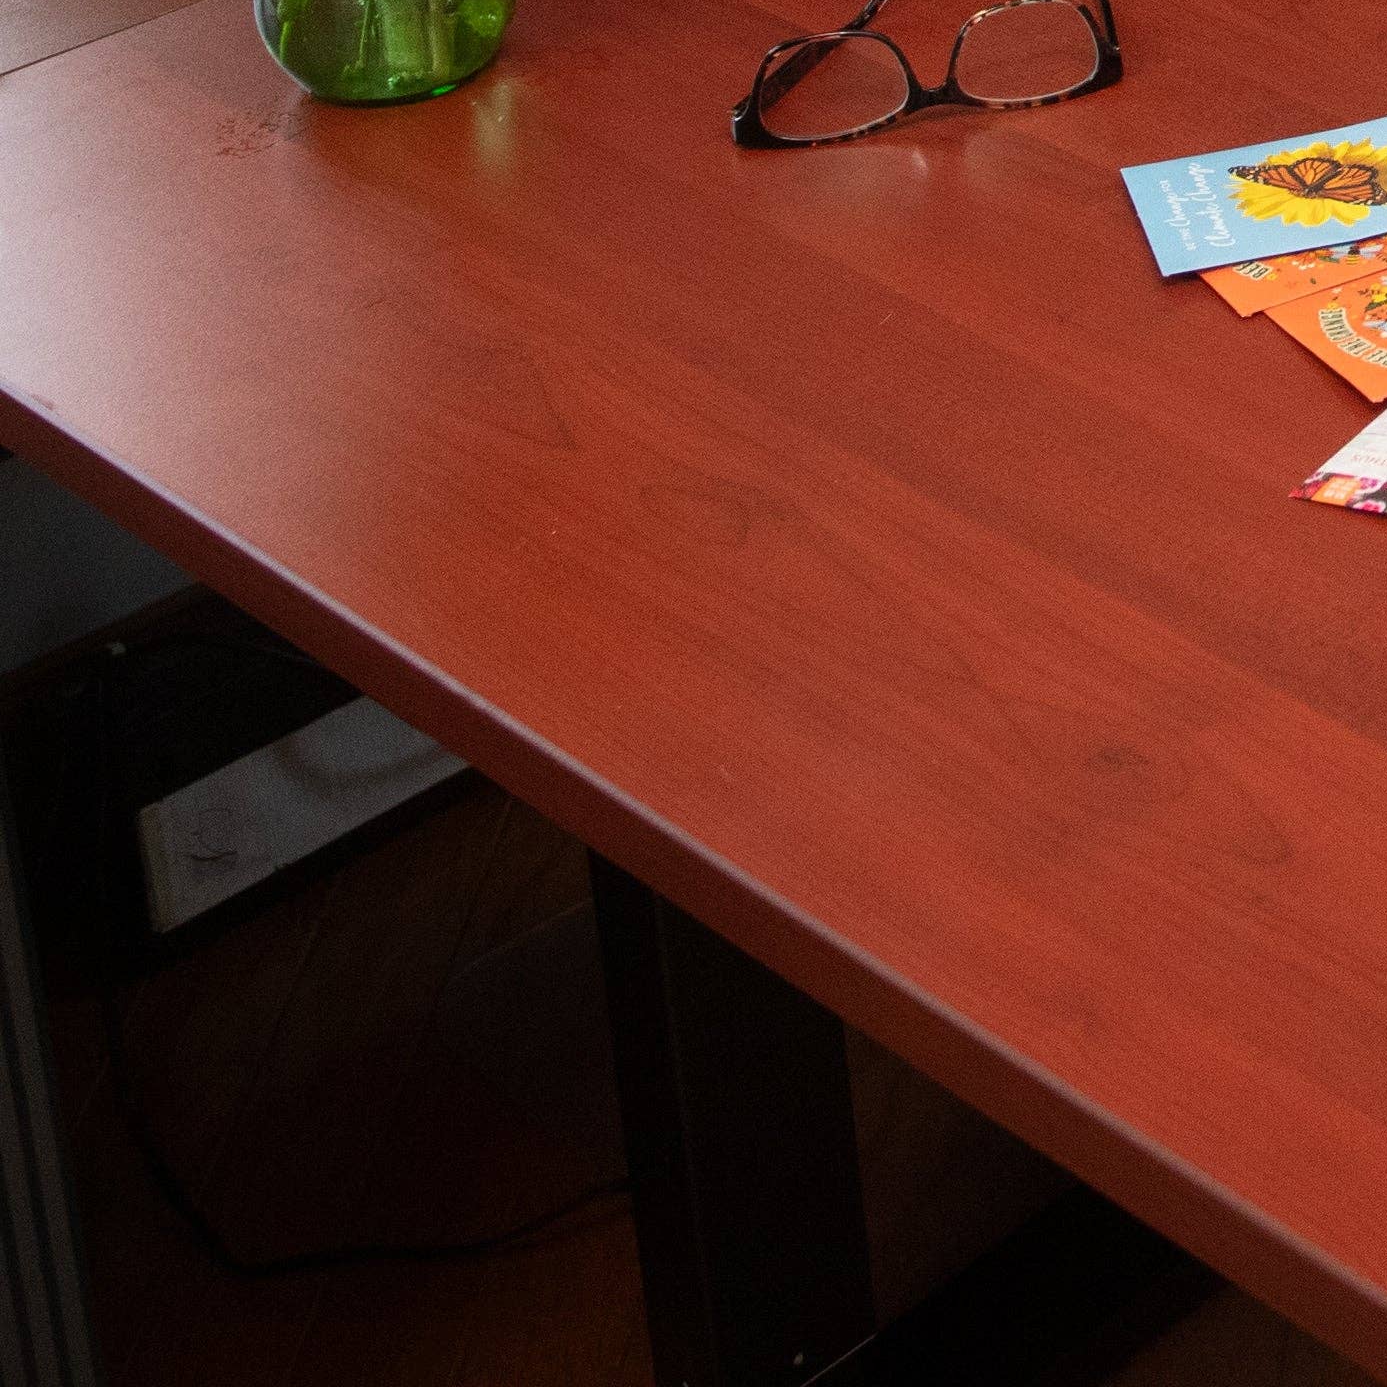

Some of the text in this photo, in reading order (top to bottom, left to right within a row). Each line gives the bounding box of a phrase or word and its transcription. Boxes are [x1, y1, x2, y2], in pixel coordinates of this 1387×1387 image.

[1164, 194, 1191, 227] Change
[1185, 163, 1236, 247] Climate Change
[1319, 308, 1355, 345] CHANGE
[1340, 336, 1373, 357] THE
